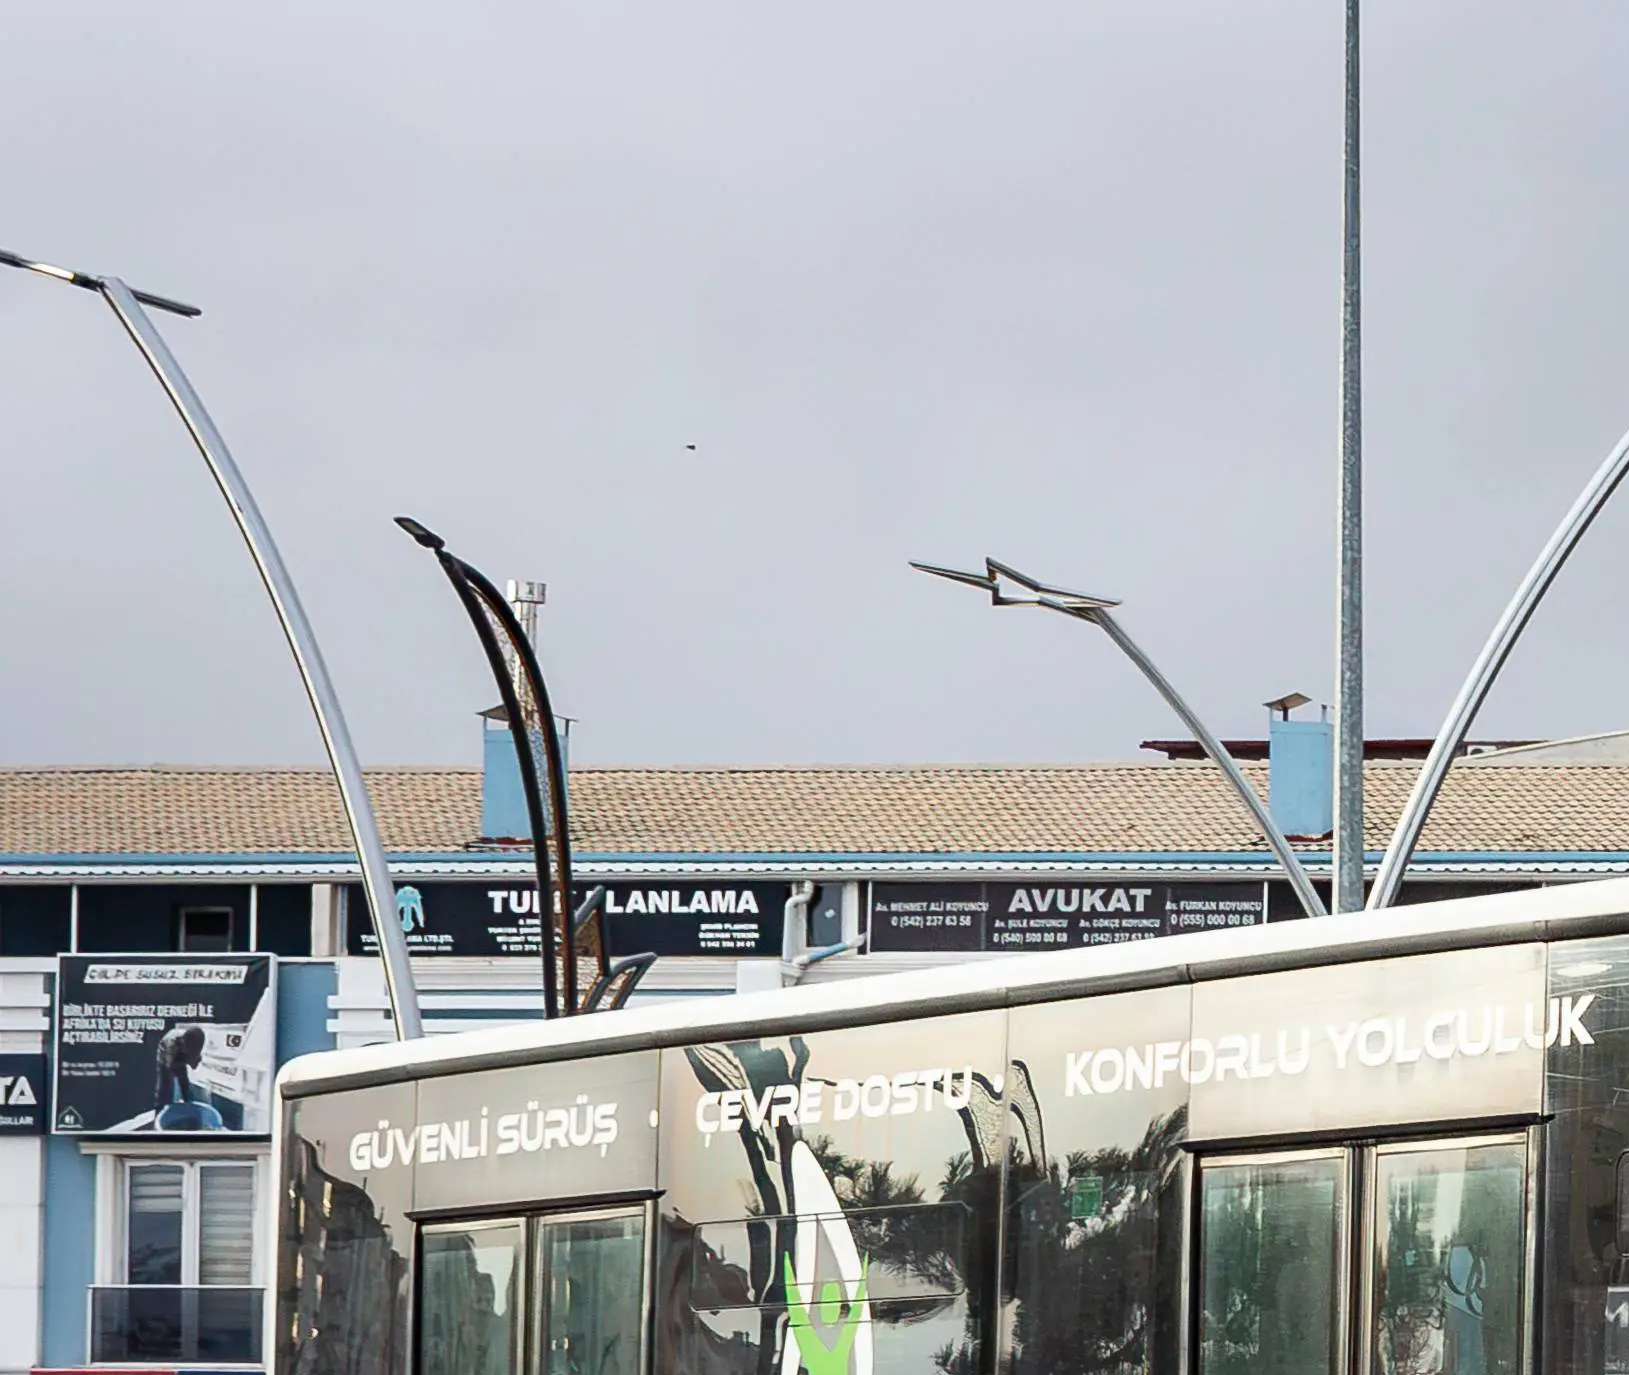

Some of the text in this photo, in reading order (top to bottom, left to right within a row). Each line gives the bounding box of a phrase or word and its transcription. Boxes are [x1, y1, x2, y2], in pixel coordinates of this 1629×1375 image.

[1008, 889, 1151, 914] AVUKAT
[1171, 914, 1178, 926] 0
[1065, 994, 1597, 1097] KONFORLU YOLCULUK
[350, 1094, 618, 1171] GÜVENLİ SÜRÜŞ
[695, 1065, 973, 1147] ÇEVRE DOSTU
